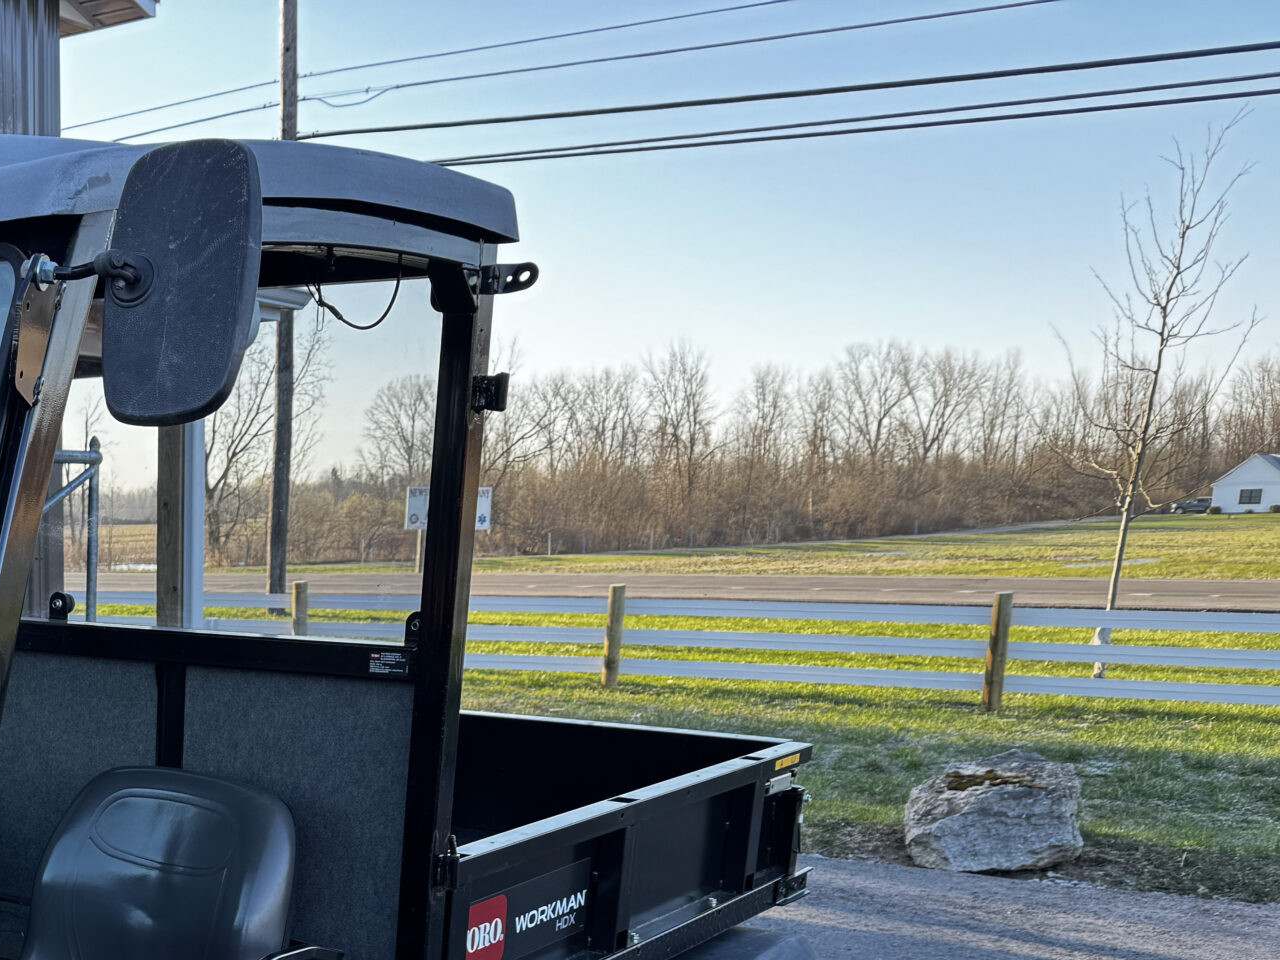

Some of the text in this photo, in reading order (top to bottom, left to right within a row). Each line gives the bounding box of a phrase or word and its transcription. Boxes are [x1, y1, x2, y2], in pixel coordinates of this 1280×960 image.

[515, 889, 588, 934] WORKMAN
[555, 912, 577, 932] HDX
[466, 917, 503, 953] ORO
